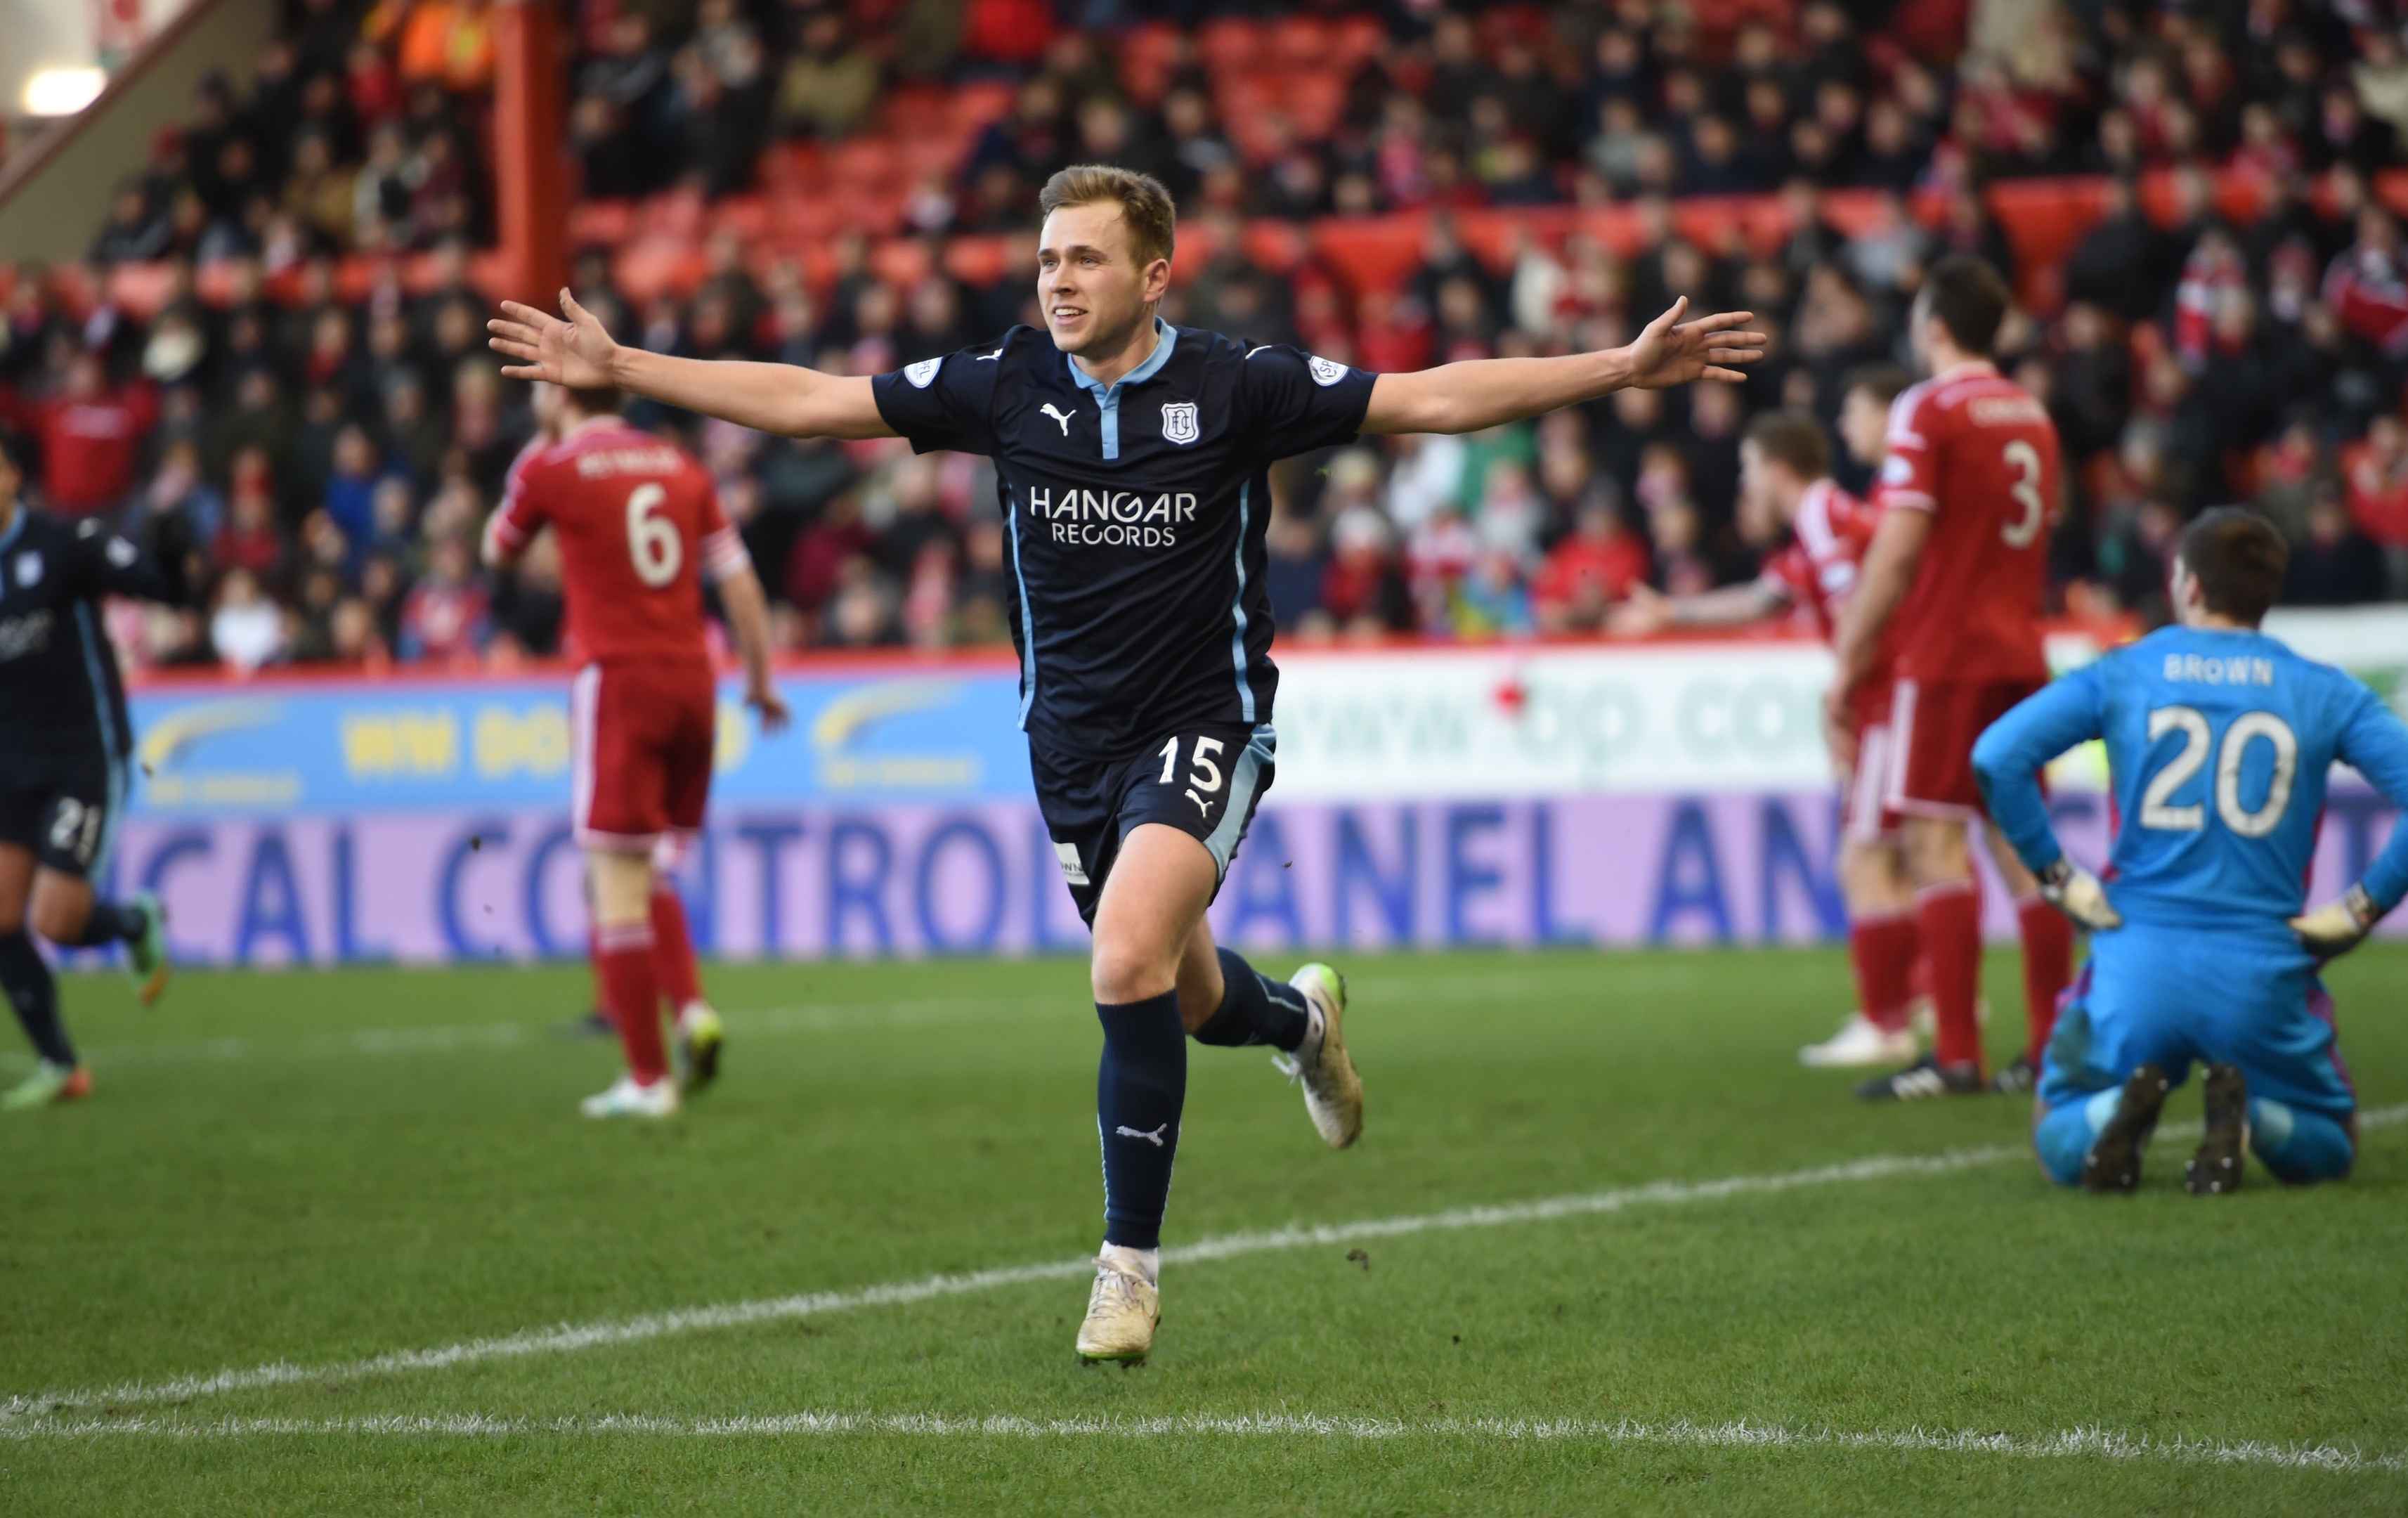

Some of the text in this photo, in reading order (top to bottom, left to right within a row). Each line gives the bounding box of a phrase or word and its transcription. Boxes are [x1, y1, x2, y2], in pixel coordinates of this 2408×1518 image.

[1030, 486, 1197, 523] HANGAR
[2001, 438, 2043, 550] 3
[626, 481, 684, 589] 6
[1051, 522, 1176, 547] RECORDS
[2163, 652, 2274, 689] BROWN
[1157, 735, 1225, 793] 15
[2139, 703, 2298, 838] 20
[48, 796, 102, 866] 21
[1228, 805, 1599, 950] ANEL
[1648, 794, 1856, 946] AN
